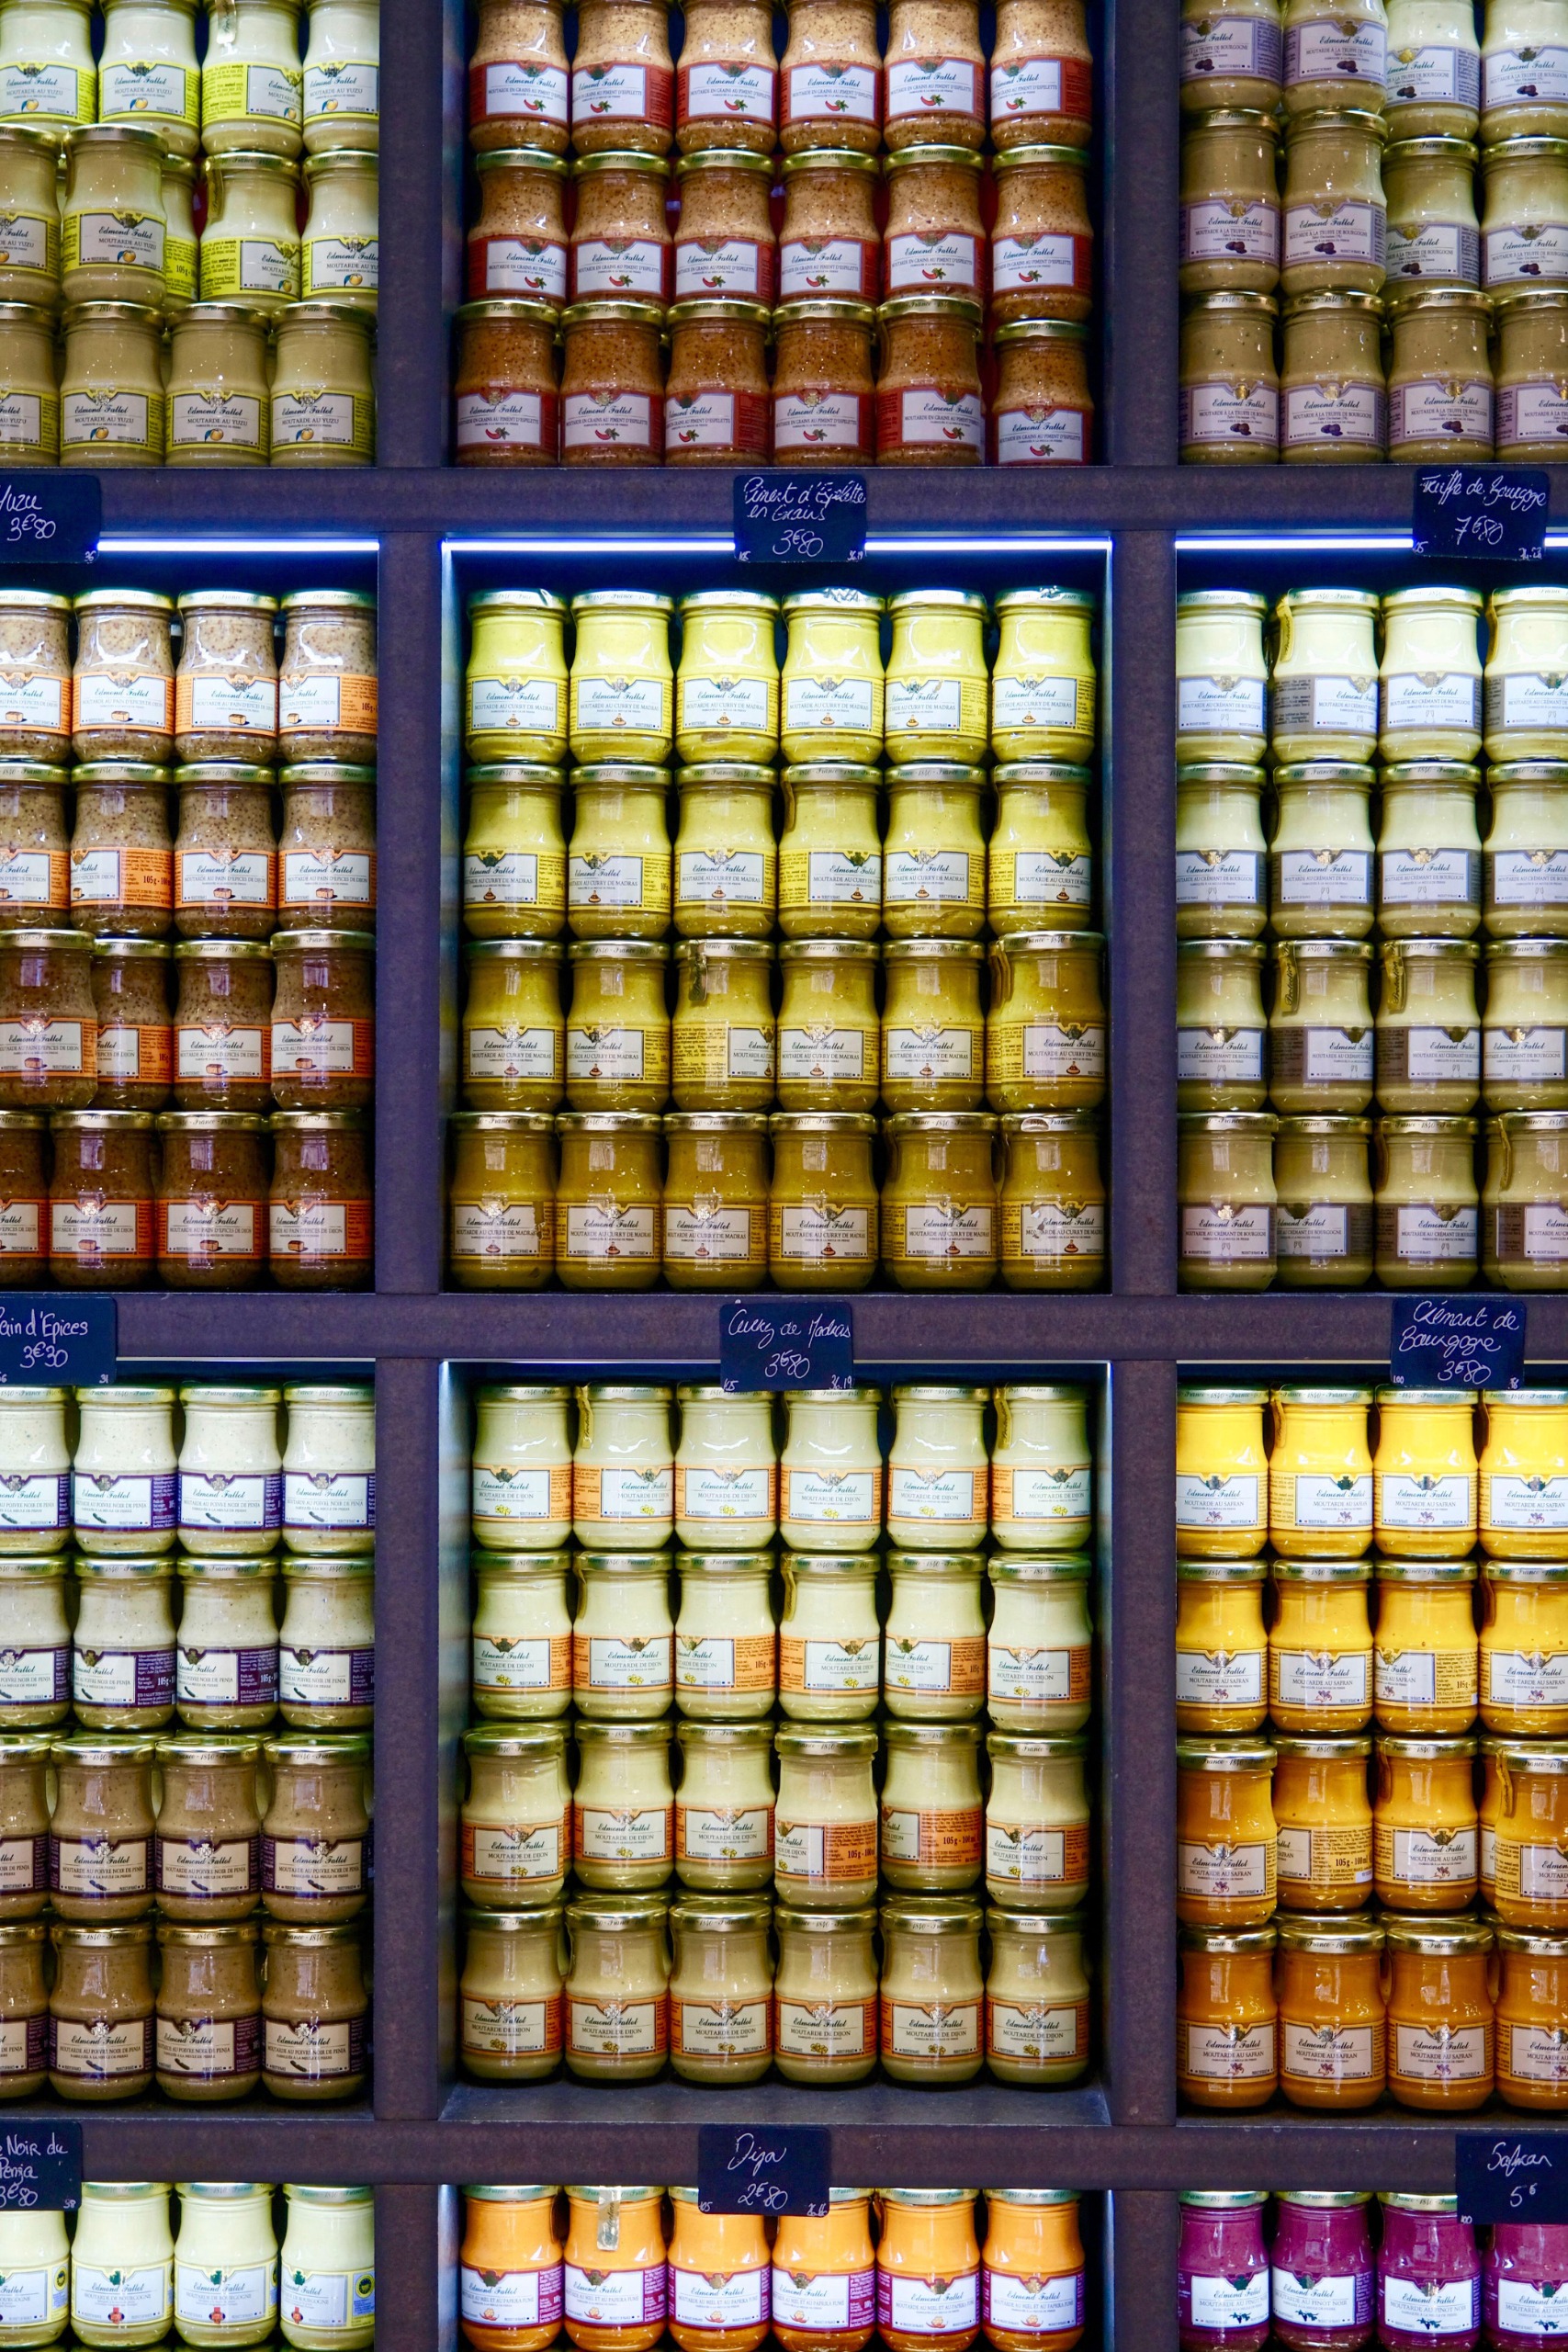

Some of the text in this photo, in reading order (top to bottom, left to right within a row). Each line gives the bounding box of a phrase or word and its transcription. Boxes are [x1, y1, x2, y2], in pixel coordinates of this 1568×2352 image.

[74, 404, 128, 413] Edmond Fallot
[578, 405, 633, 415] Edmond Fallot
[1304, 400, 1359, 410] Edmond Fallot
[1466, 477, 1483, 495] de
[183, 1216, 239, 1225] Edmond Fallot
[583, 1219, 639, 1227] Edmond Fallot
[1199, 1219, 1255, 1228] Edmond Fallot
[1493, 1310, 1519, 1330] de
[26, 1308, 88, 1344] d'Epices
[780, 1321, 802, 1336] de
[19, 1341, 69, 1368] 3€30
[904, 1482, 931, 1490] Edmond
[1398, 1489, 1453, 1498] Edmond Fallot
[73, 1855, 105, 1864] Edmond
[908, 2019, 964, 2028] Edmond Fallot
[1413, 2040, 1469, 2050] Edmond Fallot
[6, 2133, 41, 2156] Noir
[46, 2132, 69, 2154] du
